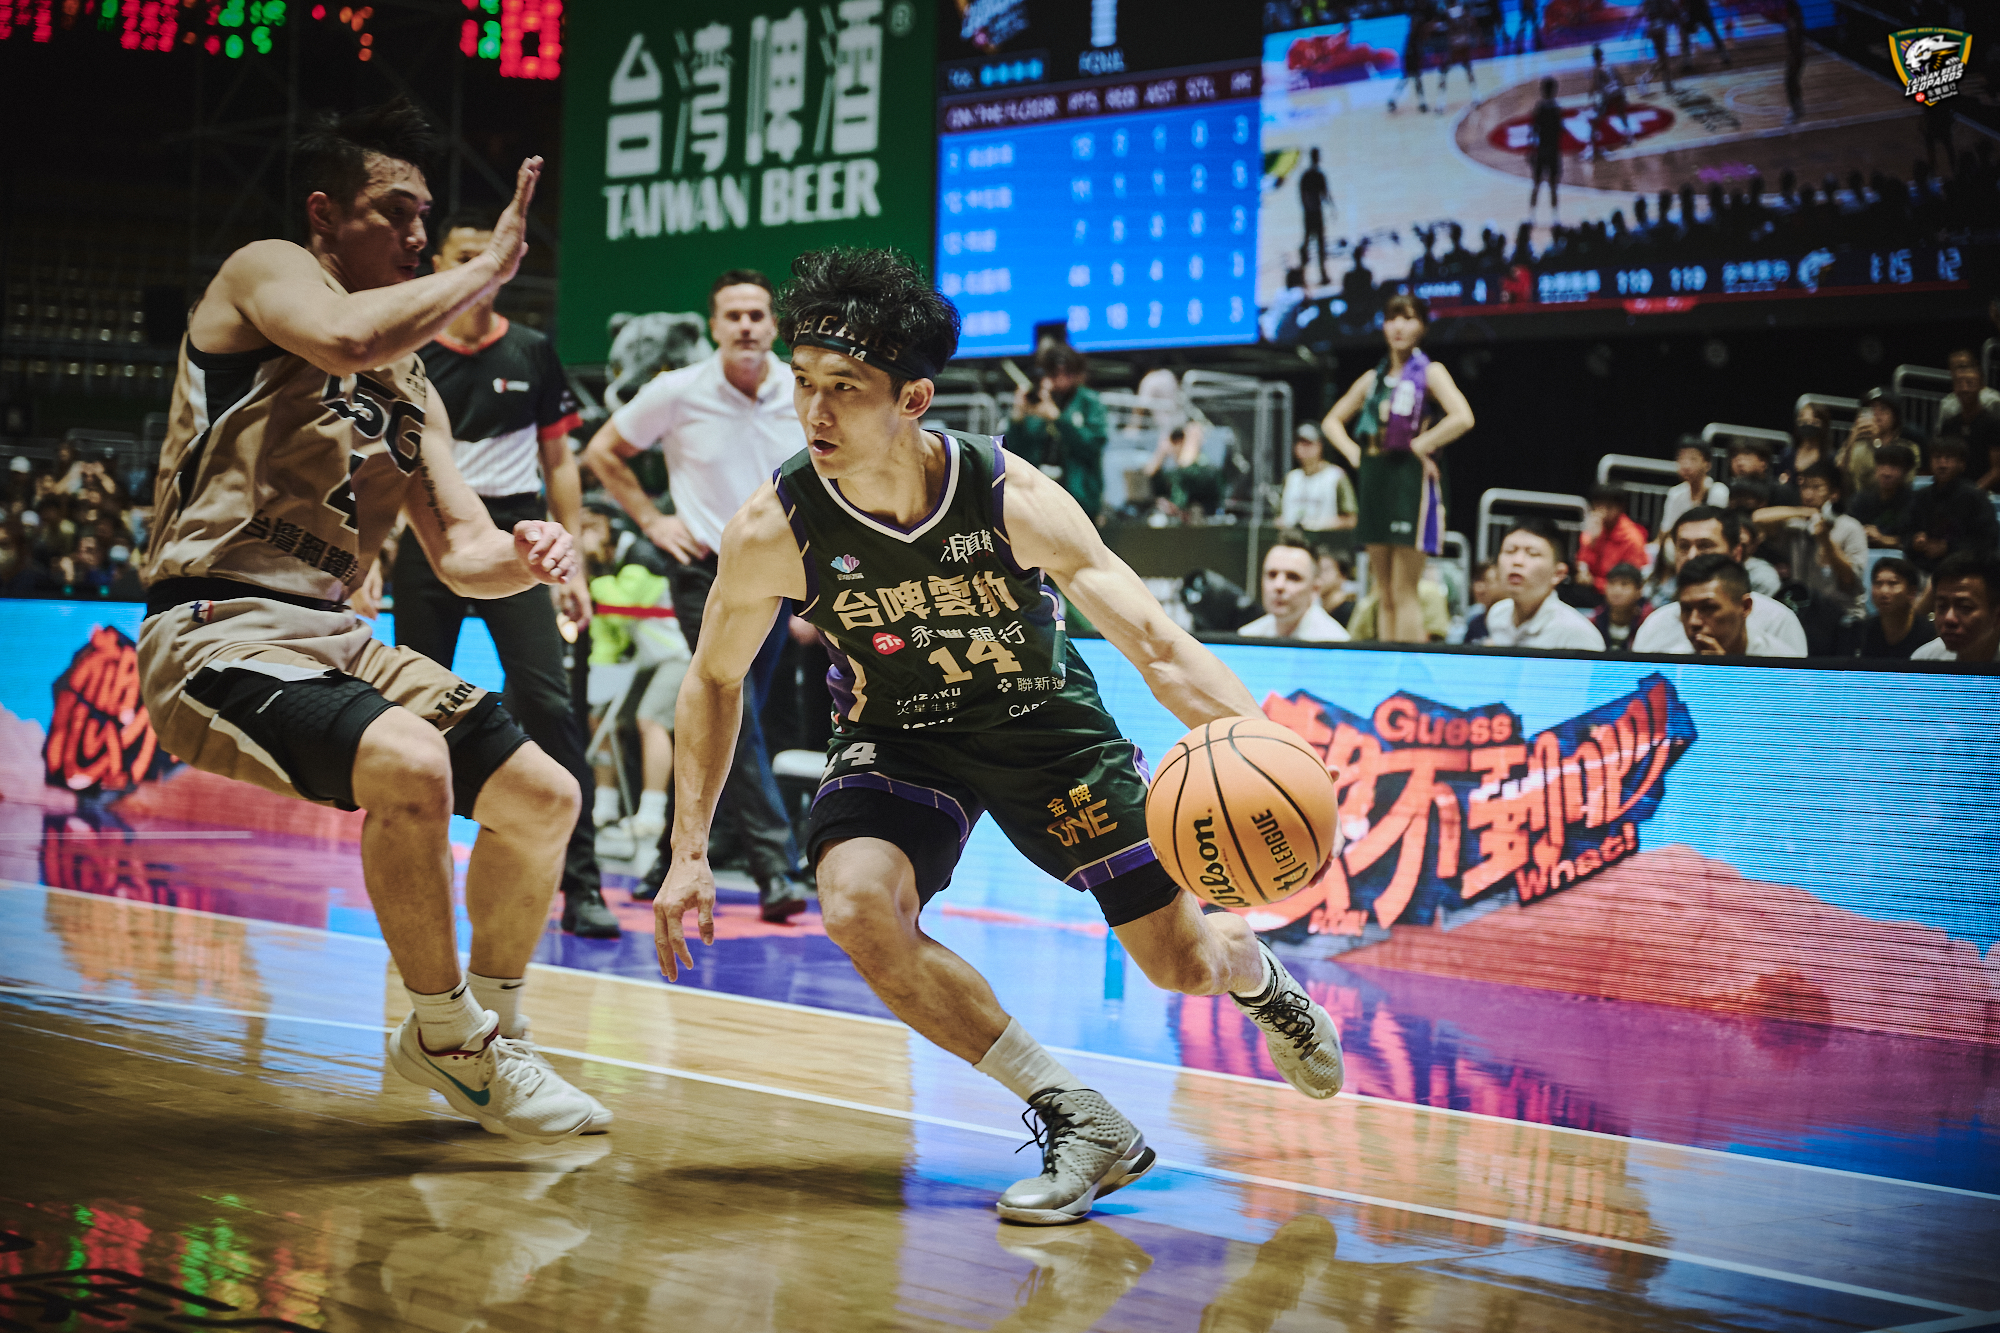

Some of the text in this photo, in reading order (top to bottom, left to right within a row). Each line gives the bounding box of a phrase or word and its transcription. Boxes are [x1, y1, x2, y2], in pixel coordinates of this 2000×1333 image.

[605, 0, 880, 178] 台灣啤酒
[603, 173, 748, 241] TAIWAN
[759, 158, 882, 227] BEER
[848, 346, 867, 362] 14
[832, 571, 1019, 630] 台啤雲豹
[927, 640, 1022, 684] 14
[1374, 696, 1513, 745] Guess
[1046, 799, 1118, 847] ONE
[1047, 784, 1092, 817] 金牌
[1250, 809, 1297, 870] LEAGUE
[1516, 822, 1637, 903] What!
